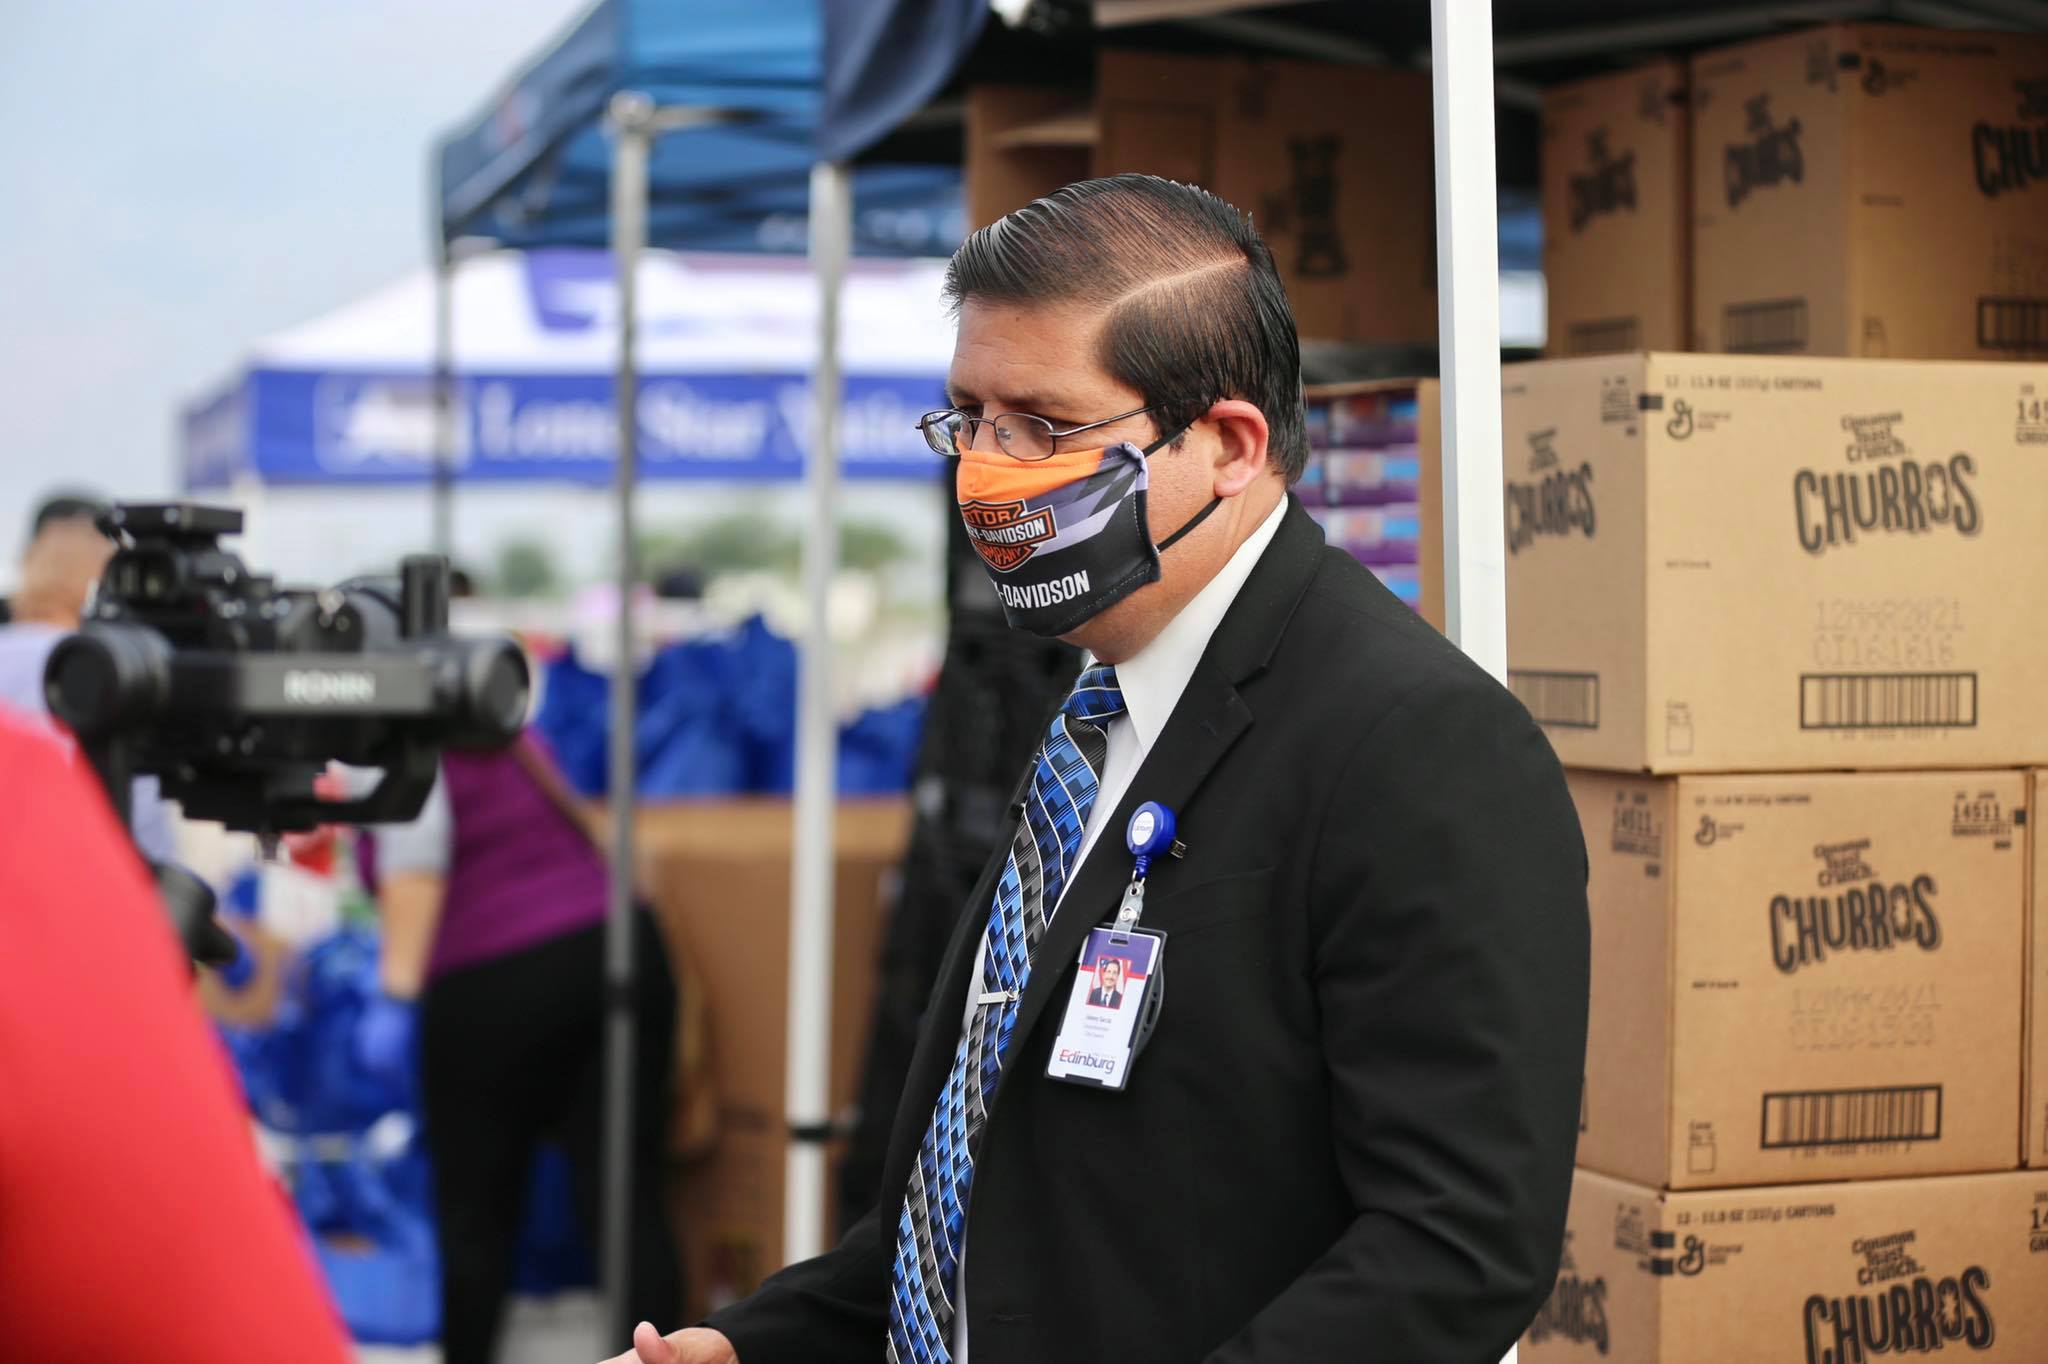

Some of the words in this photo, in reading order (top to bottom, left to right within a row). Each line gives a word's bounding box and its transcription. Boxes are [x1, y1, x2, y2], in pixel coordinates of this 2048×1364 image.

[1794, 452, 1981, 555] CHURROS
[1769, 873, 1942, 975] CHURROS
[1059, 1048, 1115, 1075] Edinburg
[1785, 1203, 1836, 1220] CARTONS
[1804, 1265, 1995, 1364] CHURROS
